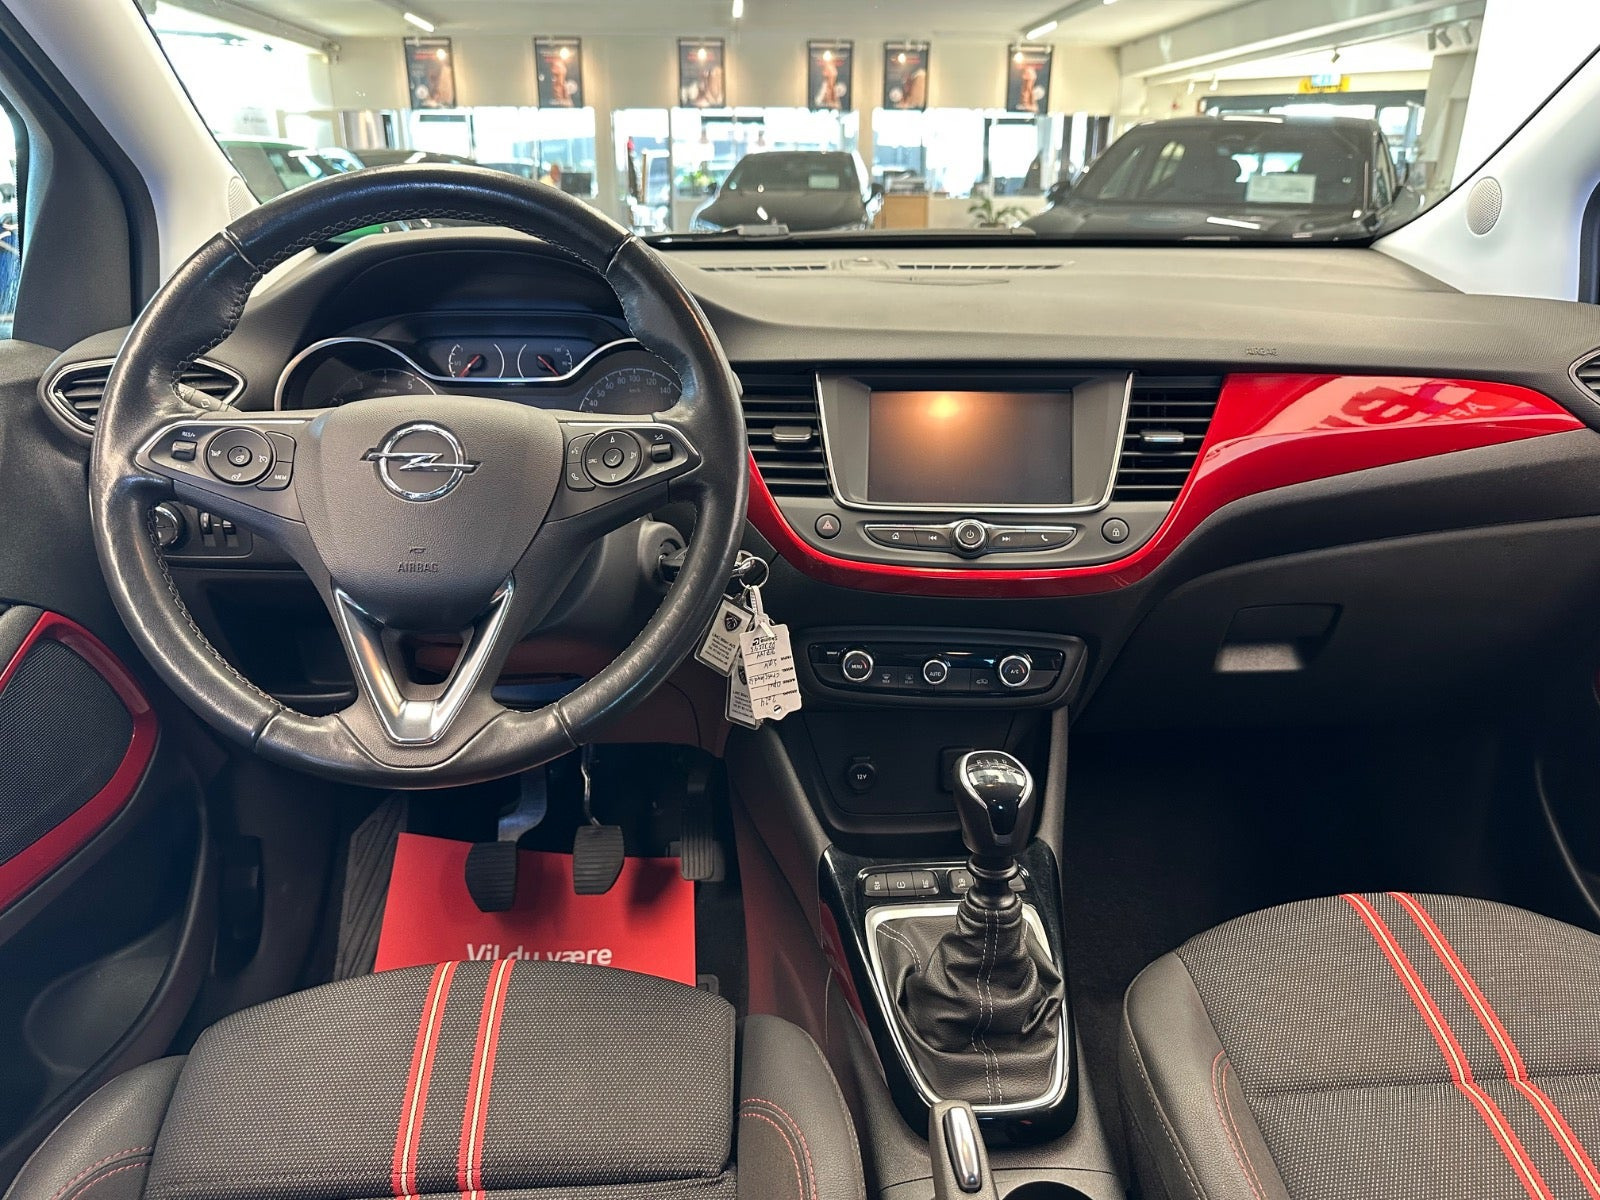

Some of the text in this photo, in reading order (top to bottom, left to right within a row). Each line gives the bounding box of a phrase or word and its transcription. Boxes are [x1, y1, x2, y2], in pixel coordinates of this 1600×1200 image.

[407, 381, 413, 389] 5
[646, 377, 657, 385] 120
[596, 390, 605, 398] 50
[588, 399, 598, 407] 40
[397, 561, 439, 573] AIRBAG
[466, 943, 613, 965] Vil du være
